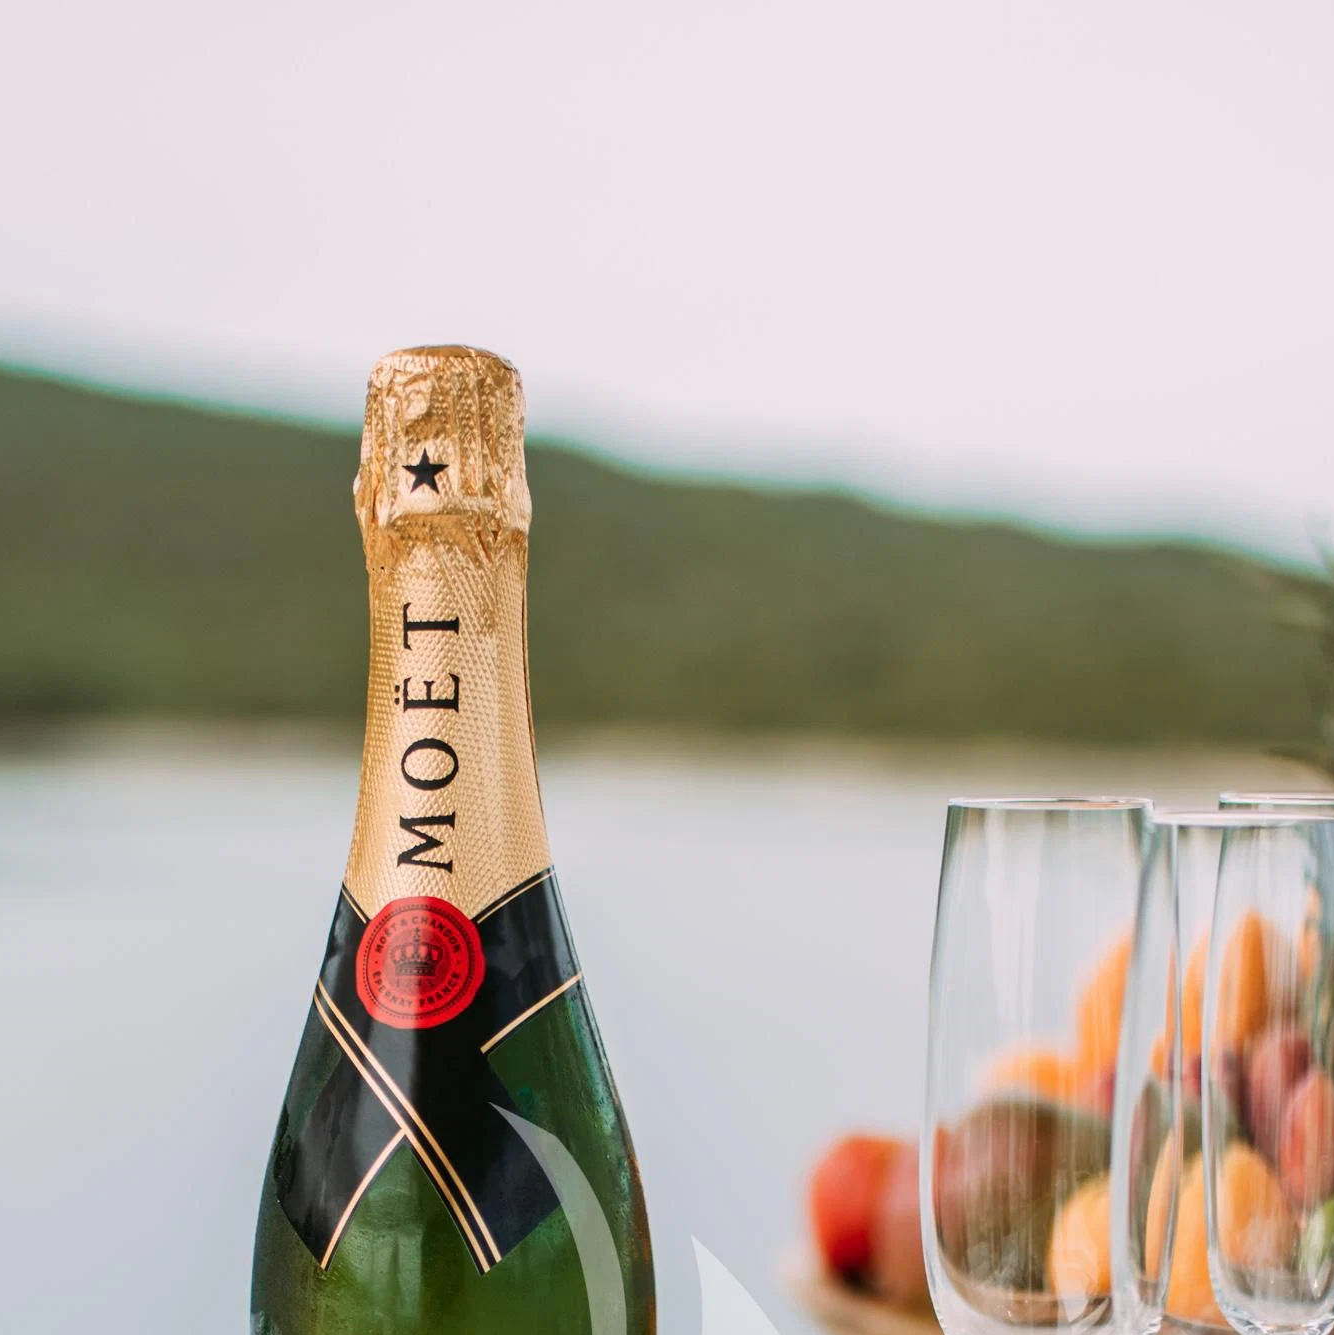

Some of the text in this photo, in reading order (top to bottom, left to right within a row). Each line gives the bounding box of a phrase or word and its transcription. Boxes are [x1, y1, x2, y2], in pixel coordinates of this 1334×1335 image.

[394, 602, 460, 873] MOËT
[411, 916, 461, 953] CHANDON
[419, 971, 460, 1005] FRANCE
